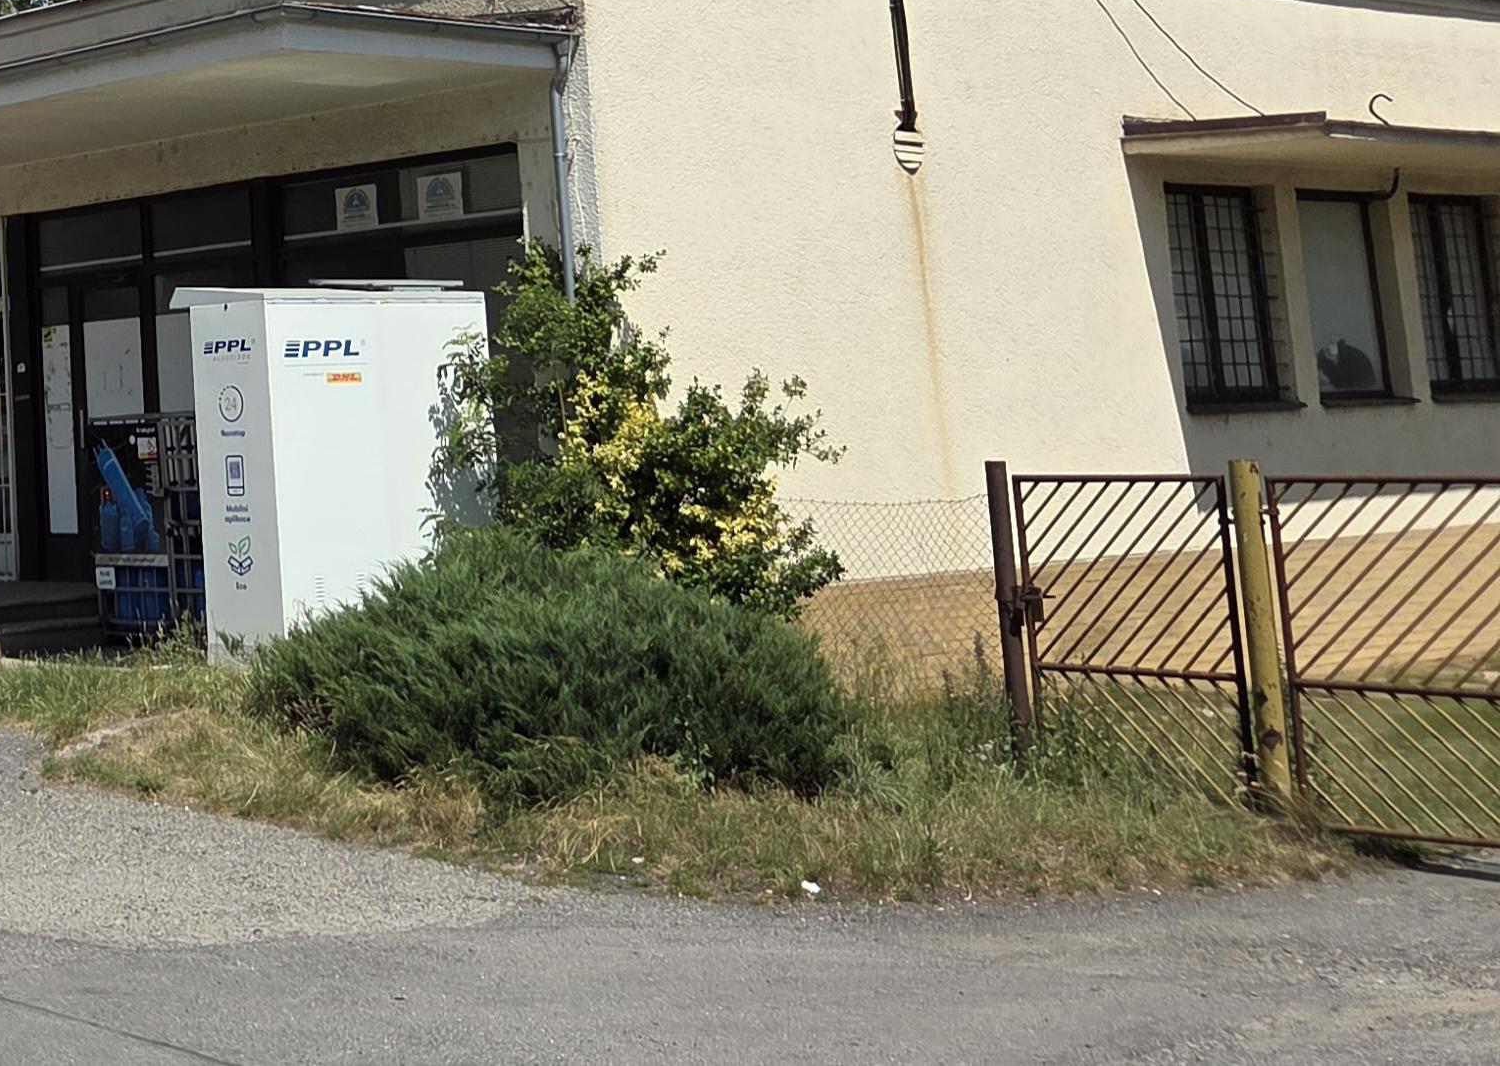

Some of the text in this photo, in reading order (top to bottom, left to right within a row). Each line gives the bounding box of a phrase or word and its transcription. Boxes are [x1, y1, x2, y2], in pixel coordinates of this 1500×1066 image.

[214, 338, 251, 354] PPL
[302, 339, 359, 358] PPL
[331, 372, 357, 382] DHL
[224, 397, 237, 411] 24
